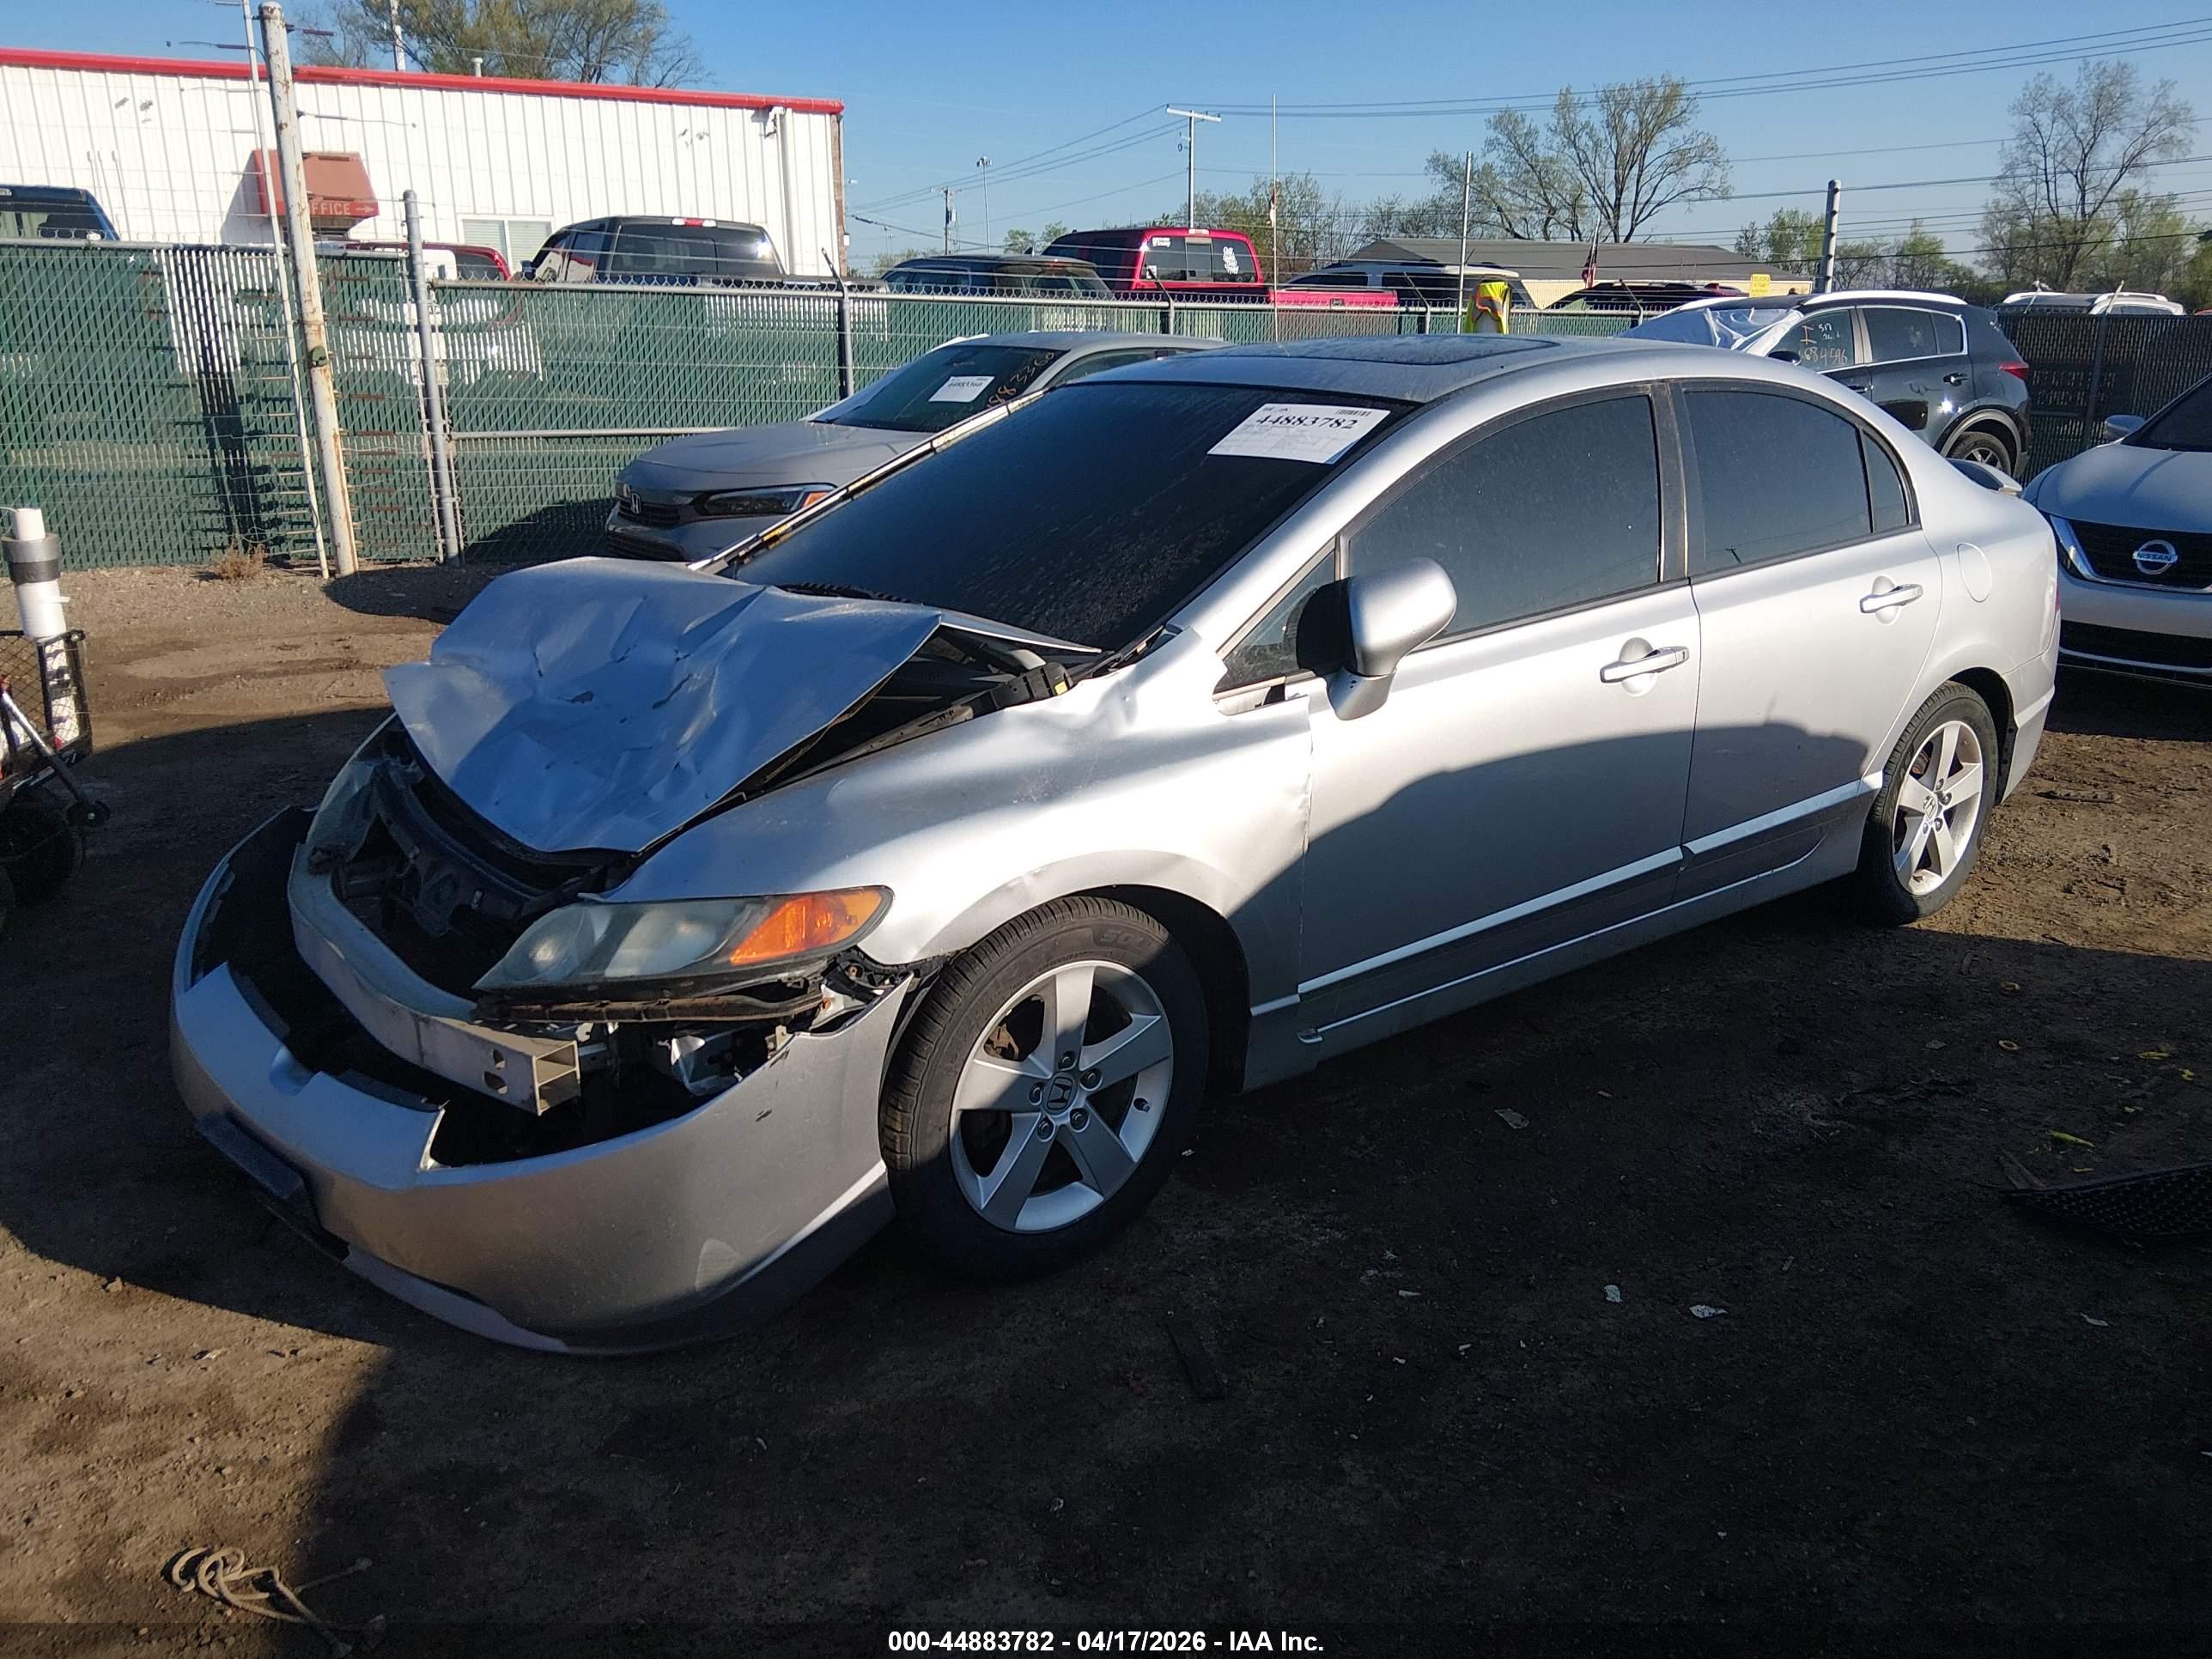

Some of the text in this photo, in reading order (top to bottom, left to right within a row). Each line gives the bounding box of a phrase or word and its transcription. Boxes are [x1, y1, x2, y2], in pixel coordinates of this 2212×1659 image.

[311, 202, 351, 216] FFICE
[1255, 414, 1358, 429] 44883782
[2136, 551, 2172, 562] NISSAN
